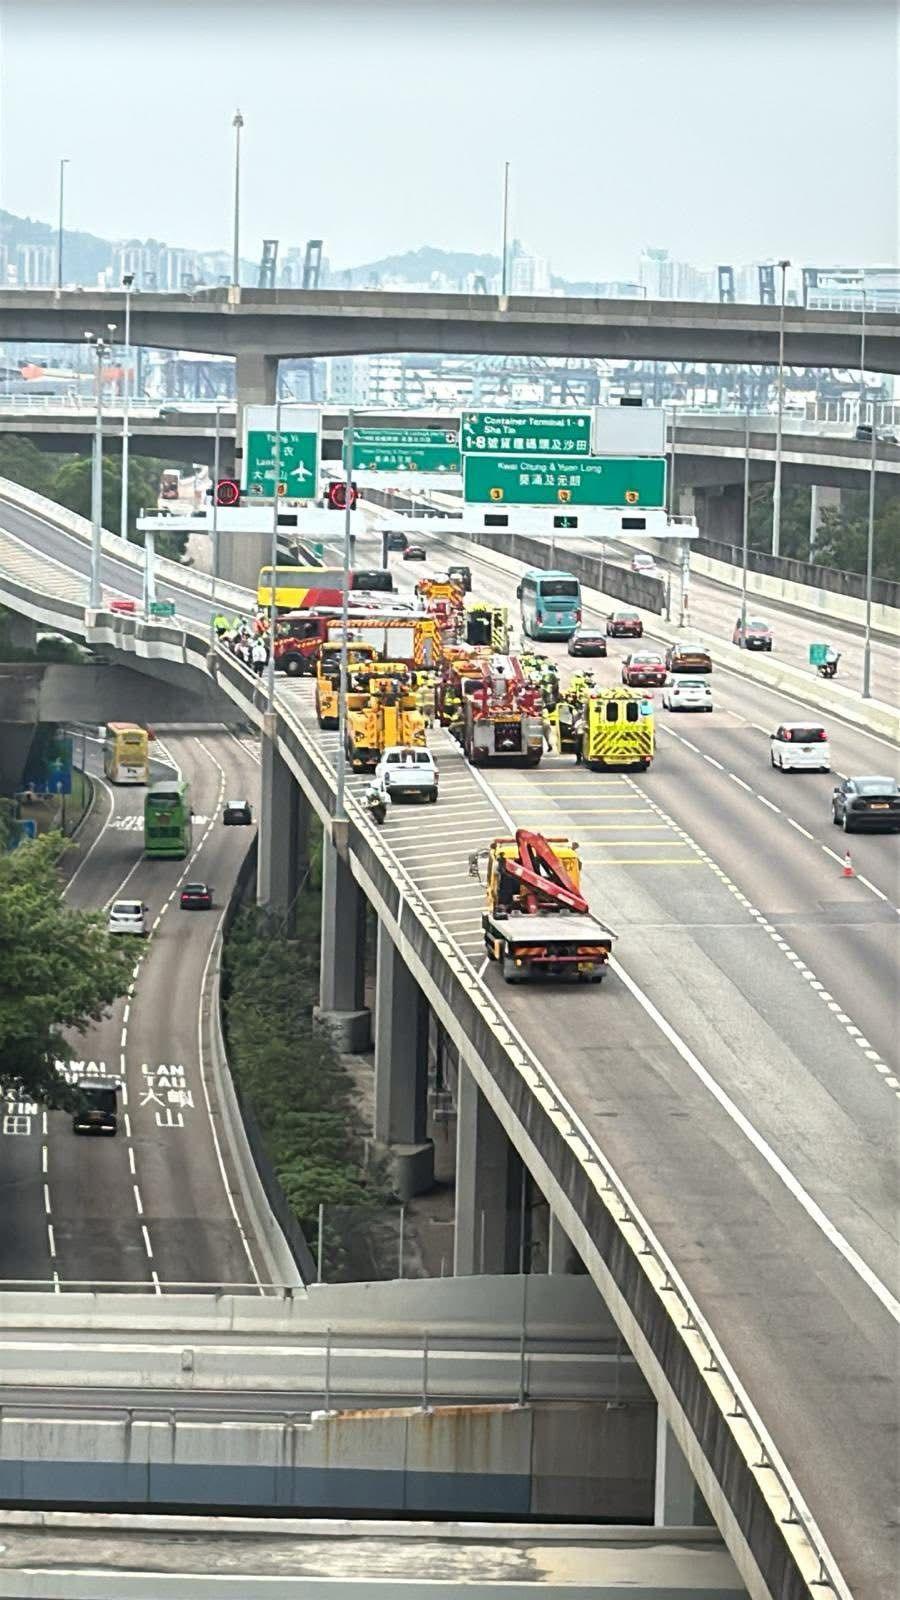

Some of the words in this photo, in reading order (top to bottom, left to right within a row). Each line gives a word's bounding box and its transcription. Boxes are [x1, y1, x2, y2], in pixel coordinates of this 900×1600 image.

[484, 416, 527, 426] Container
[529, 417, 564, 427] Terminal
[484, 425, 501, 435] Sha
[503, 426, 516, 434] Tin
[266, 433, 289, 444] Tsng
[255, 458, 285, 467] Lantu
[520, 462, 546, 472] Chung
[580, 463, 602, 474] Long
[54, 1060, 106, 1073] KWAI
[141, 1063, 184, 1075] LAN
[145, 1075, 186, 1088] TAU
[6, 1102, 38, 1115] TIN
[155, 1108, 185, 1127] 山
[3, 1115, 31, 1136] 田
